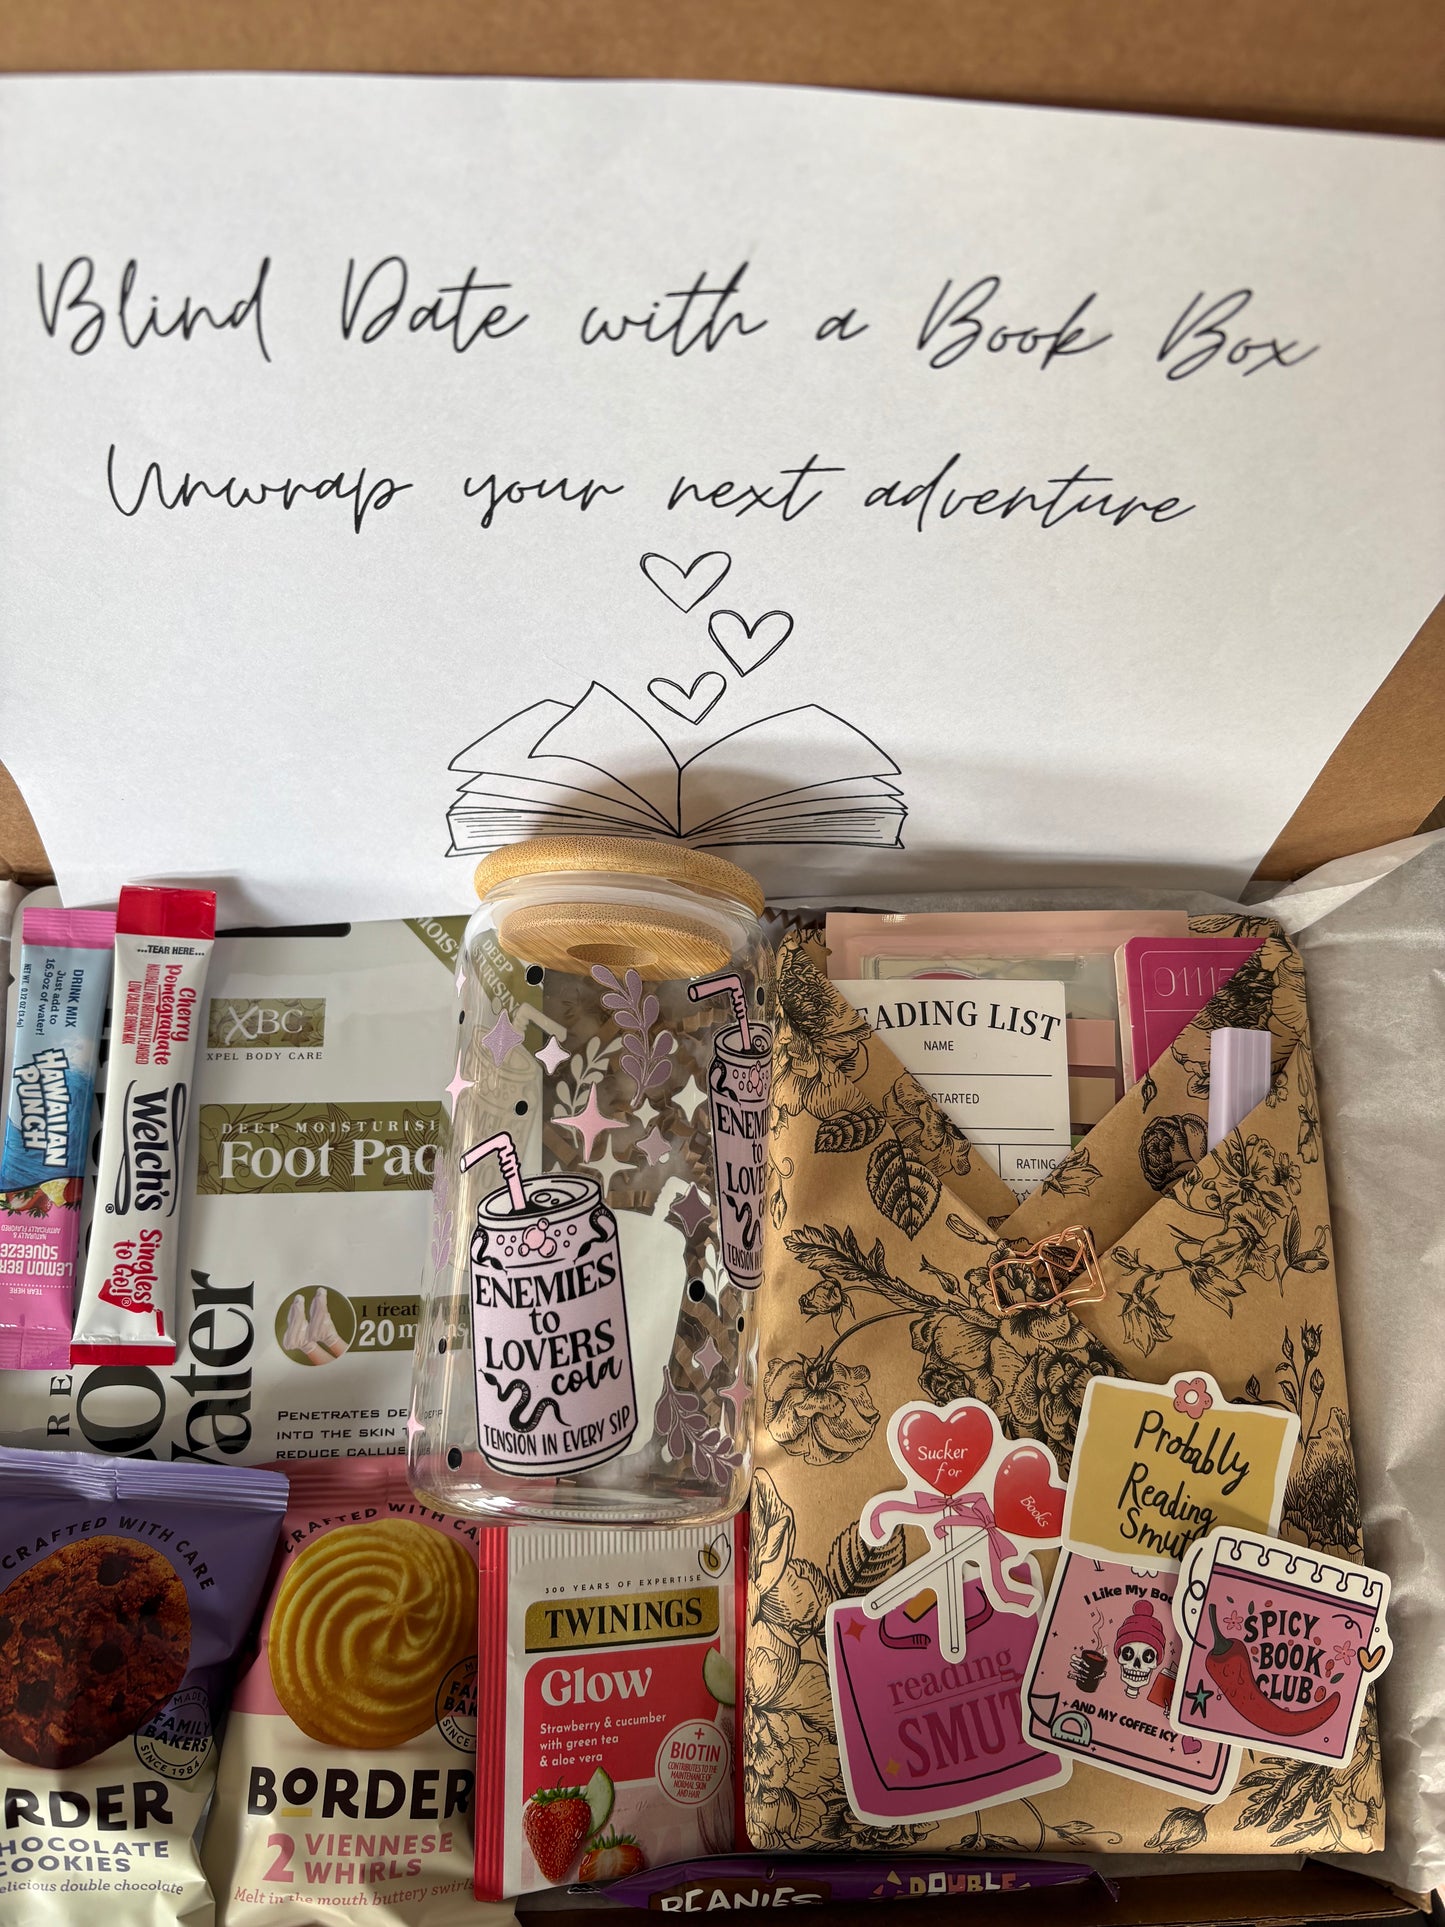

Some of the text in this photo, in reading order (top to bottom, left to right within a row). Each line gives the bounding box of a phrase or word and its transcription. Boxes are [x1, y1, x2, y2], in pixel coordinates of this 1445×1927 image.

[37, 255, 1321, 381] Blind Date with a Book Box
[107, 443, 1196, 534] Unwrap your next adventure
[23, 963, 32, 974] NET
[482, 940, 513, 972] DEEP
[144, 963, 160, 992] NATURALLY
[35, 958, 56, 1036] 16.9oz of water!
[49, 970, 66, 1025] Just add to
[65, 969, 84, 1028] DRINK MIX
[142, 992, 156, 1004] AND
[122, 980, 142, 1044] LOW CALORIE DRINK MIX
[171, 987, 197, 1042] Cherry
[224, 1005, 304, 1046] XBC
[988, 1003, 1061, 1042] LIST
[135, 1036, 152, 1065] FLAVORED
[207, 1051, 323, 1061] XPEL BODY CARE
[923, 1040, 954, 1051] NAME
[13, 1062, 48, 1150] PUNCH
[33, 1048, 71, 1168] HAWAIIAN
[931, 1092, 980, 1104] STARTED
[222, 1119, 437, 1134] DEEP MOISTURISI
[132, 1086, 171, 1211] Welch's
[220, 1137, 437, 1178] Foot Pac
[752, 1141, 763, 1164] to
[726, 1161, 767, 1196] LOVE
[1016, 1158, 1056, 1170] RATING
[113, 1240, 136, 1259] to
[727, 1243, 753, 1271] TENSION
[0, 1259, 24, 1275] BER
[134, 1229, 163, 1304] Singles
[475, 1252, 616, 1309] ENEMIES
[358, 1319, 395, 1347] 20
[529, 1307, 560, 1336] to
[485, 1318, 615, 1371] LOVERS
[551, 1355, 623, 1396] cola
[277, 1408, 380, 1421] PENETRATES
[276, 1430, 314, 1440] INTO
[321, 1429, 352, 1439] THE
[359, 1427, 395, 1438] SKIN
[484, 1405, 631, 1456] TENSION IN EVERY SIP
[276, 1448, 340, 1459] REDUCE
[917, 1439, 968, 1462] Sucker
[1133, 1409, 1250, 1495] Probably
[933, 1461, 962, 1485] for
[1020, 1496, 1051, 1528] Books
[1117, 1461, 1218, 1540] Reading
[284, 1502, 446, 1554] CRAFTED WITH
[1, 1515, 215, 1591] CRAFTED WITH CARE
[545, 1573, 702, 1594] 300 YEARS OF EXPERTISE
[1083, 1584, 1148, 1606] I Like My
[544, 1597, 703, 1639] TWININGS
[1243, 1609, 1321, 1644] SPICY
[1258, 1641, 1327, 1680] BOOK
[541, 1666, 653, 1707] Glow
[886, 1648, 1024, 1706] reading
[1255, 1673, 1316, 1705] CLUB
[153, 1711, 210, 1736] FAMILY
[442, 1719, 471, 1748] SINCE
[539, 1711, 667, 1736] Strawberry & cucumber
[1070, 1698, 1179, 1743] AND MY COFFEE ICY
[144, 1724, 209, 1753] BAKERS
[539, 1735, 619, 1752] with green tea
[670, 1741, 721, 1762] BIOTIN
[140, 1744, 168, 1772] SINCE
[539, 1752, 603, 1768] & aloe vera
[667, 1761, 718, 1774] CONTRIBUTES THE
[670, 1770, 713, 1781] MAINTENANCE OF
[673, 1780, 707, 1790] NORMAL SKIN
[248, 1766, 476, 1820] BORDER
[676, 1788, 700, 1798] AND HAIR
[262, 1832, 296, 1883] 2
[304, 1832, 453, 1858] VIENNESE
[304, 1858, 422, 1884] WHIRLS
[909, 1871, 1018, 1895] DOUBLE
[60, 1878, 110, 1892] double
[114, 1879, 184, 1895] chocolate
[233, 1877, 475, 1906] Melt in the mouth buttery swirls
